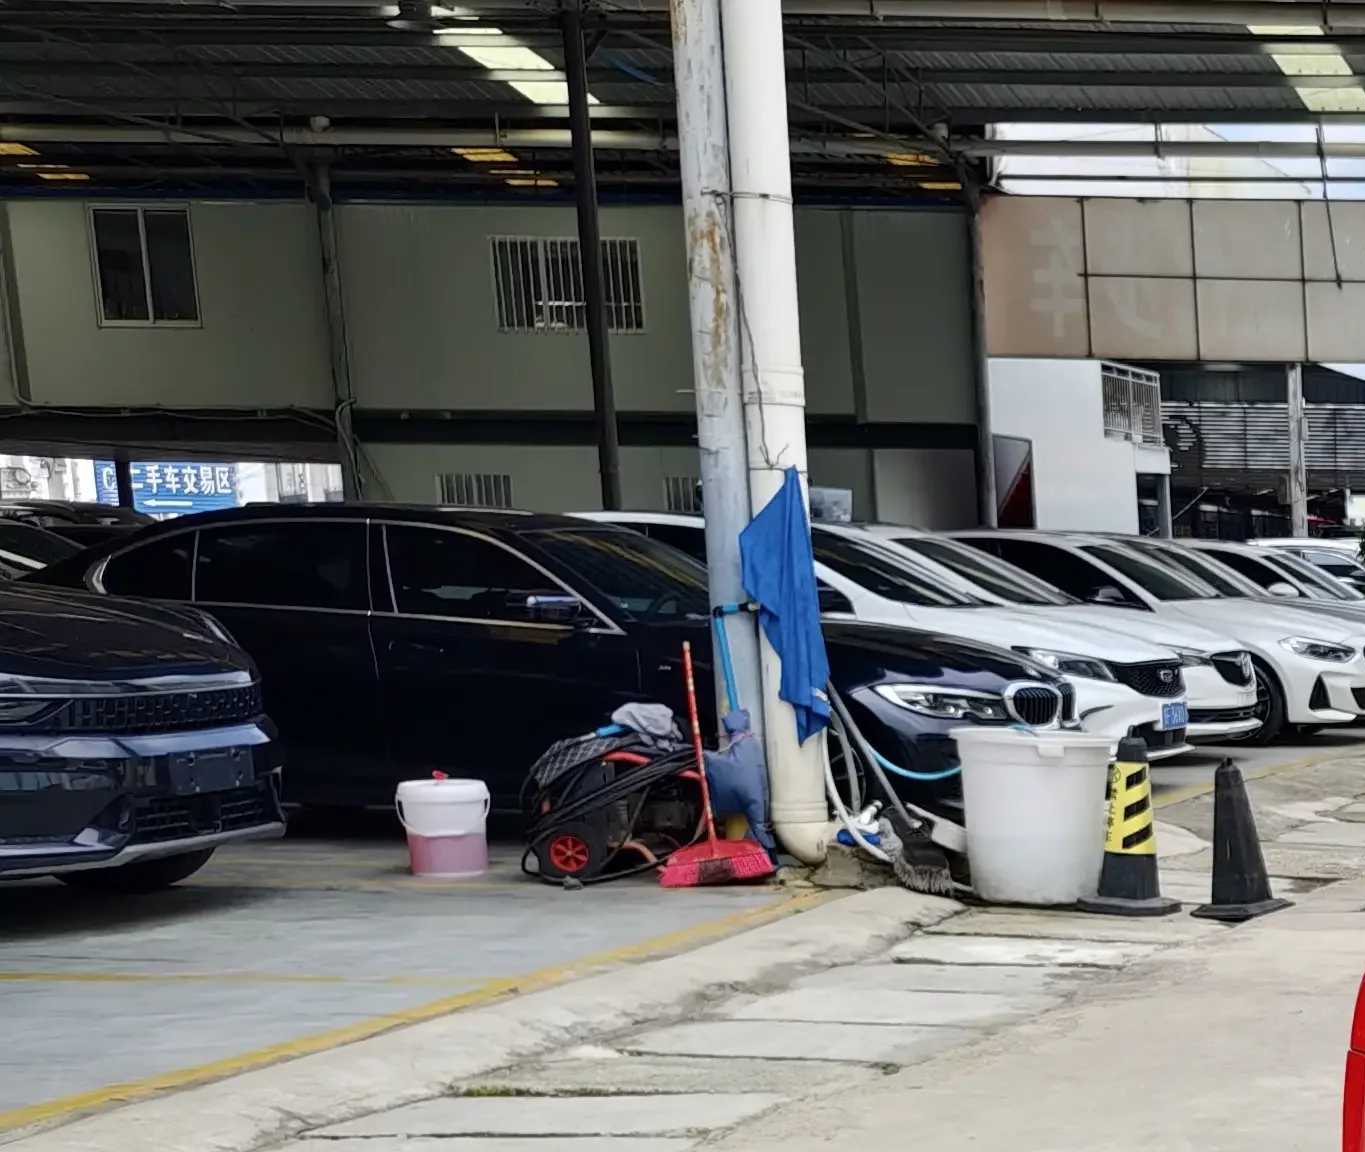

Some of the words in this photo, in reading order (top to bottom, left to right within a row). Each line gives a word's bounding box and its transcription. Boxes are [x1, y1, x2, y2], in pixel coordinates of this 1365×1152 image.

[102, 463, 232, 495] C二手车交易区
